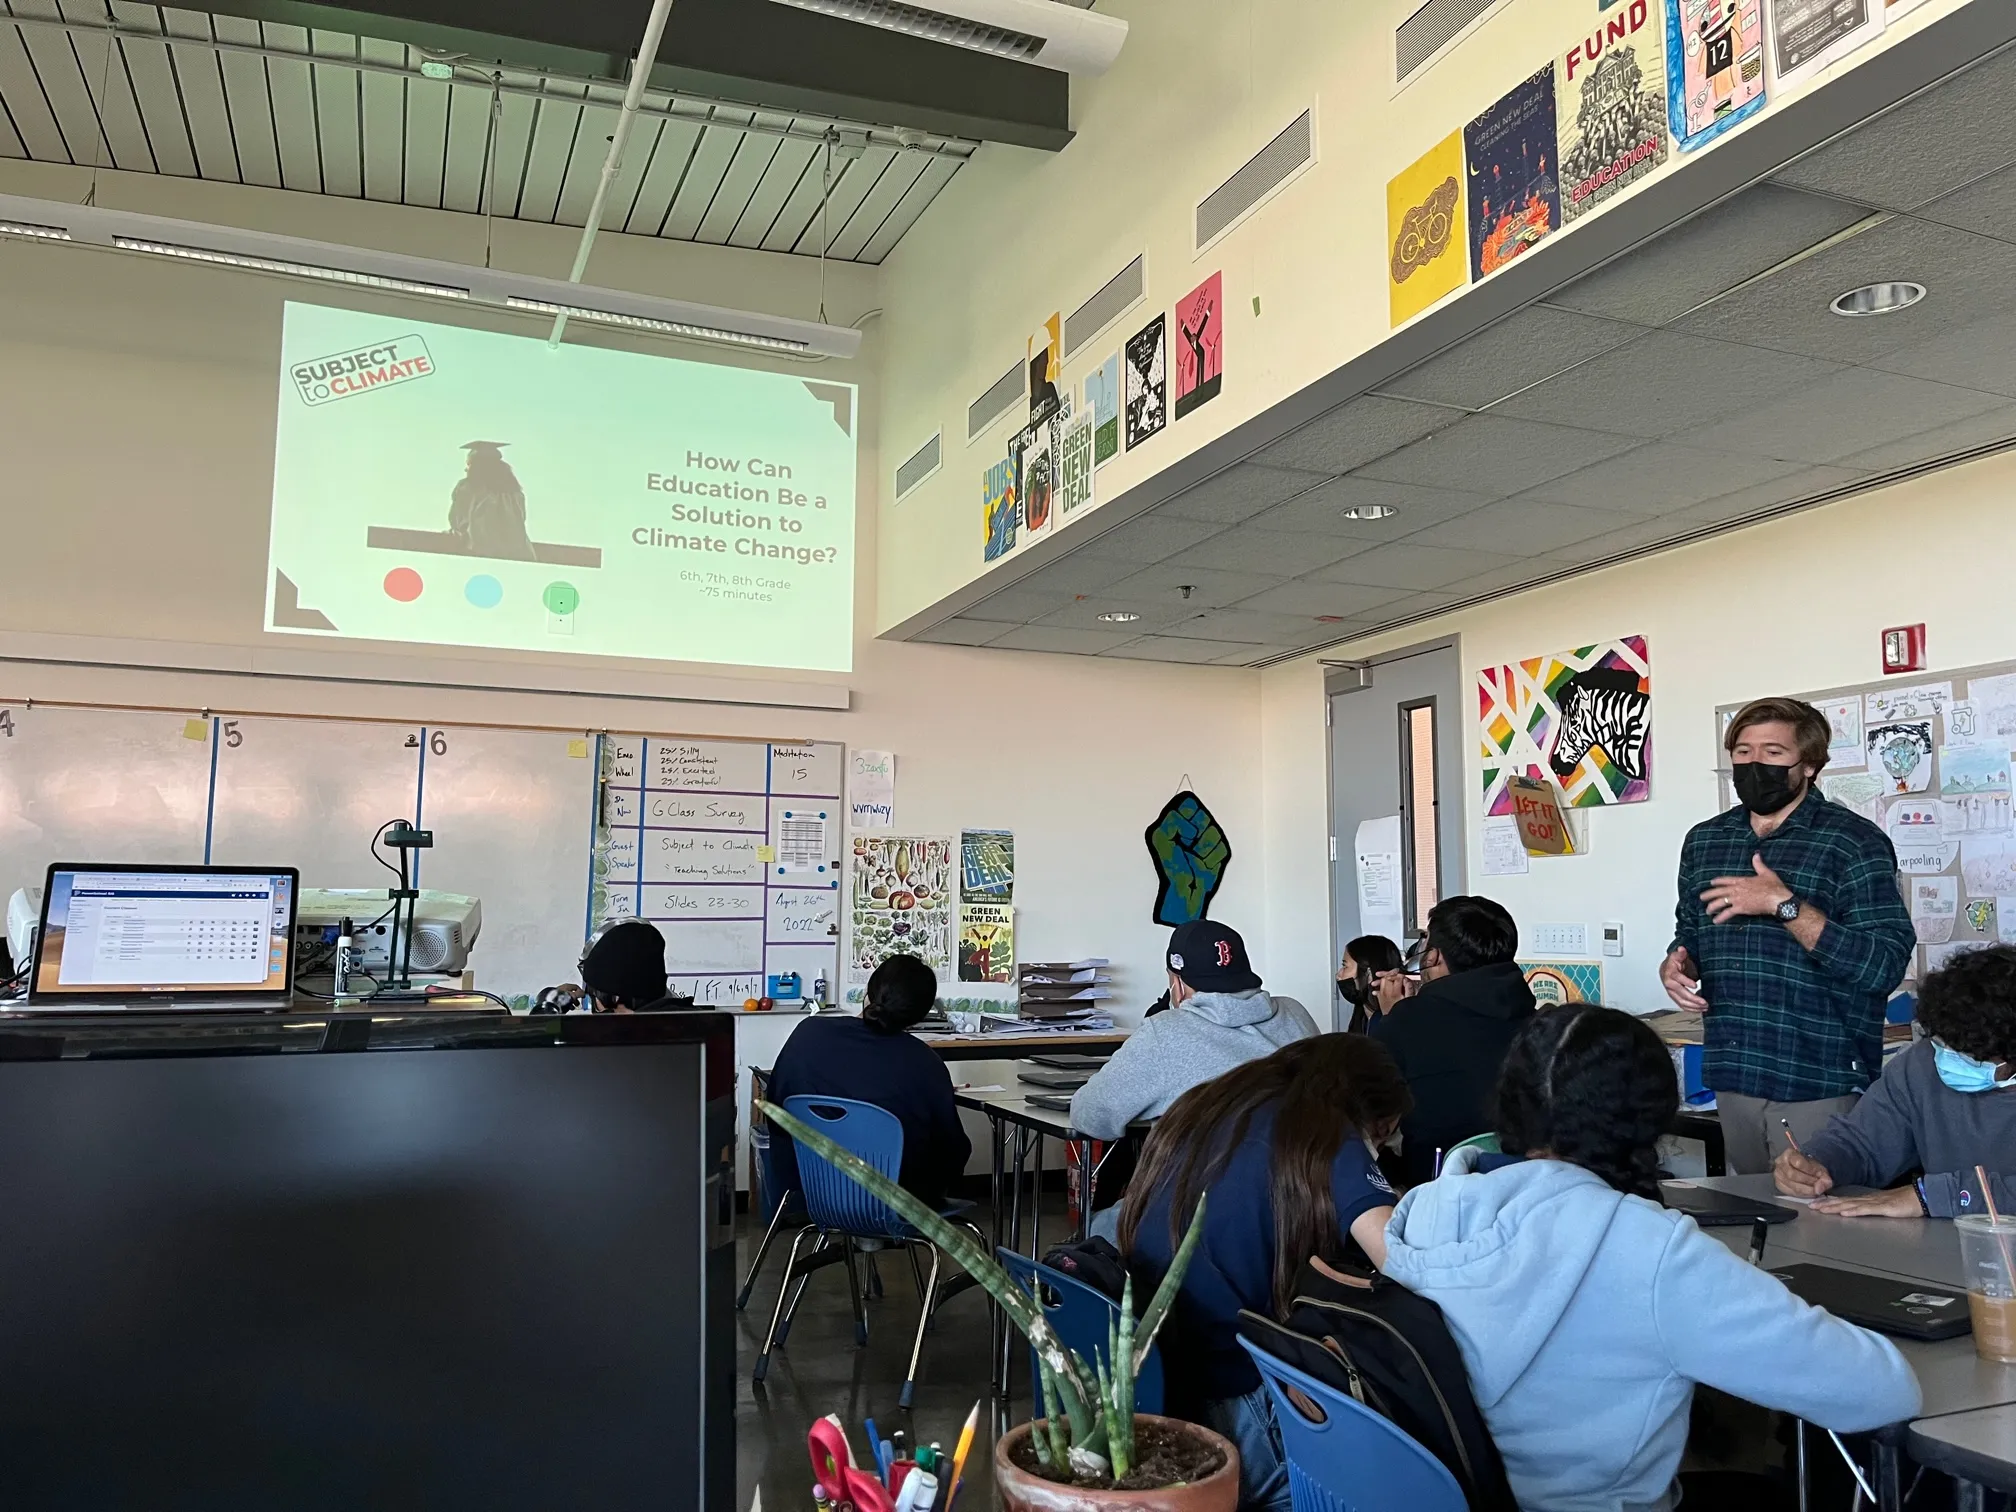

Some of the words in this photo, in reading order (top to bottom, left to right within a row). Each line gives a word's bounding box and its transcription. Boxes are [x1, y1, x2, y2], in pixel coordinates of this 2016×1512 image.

[1566, 0, 1647, 82] FUND
[1710, 39, 1728, 66] 12
[1474, 122, 1501, 146] GREEN
[1502, 106, 1521, 125] NEW
[1523, 84, 1544, 111] DEAL
[1480, 127, 1510, 152] CLEANING
[1510, 117, 1521, 130] THE
[1522, 104, 1539, 121] SEAS
[1572, 134, 1658, 204] EDUCATION
[295, 345, 398, 385] SUBJECT
[1063, 421, 1092, 458] GREEN
[686, 450, 740, 473] How
[747, 458, 792, 479] Can
[1063, 442, 1092, 488] NEW
[647, 473, 769, 503] Education
[777, 488, 808, 507] Be
[814, 495, 827, 509] a
[1063, 474, 1091, 514] DEAL
[671, 503, 771, 531] Solution
[779, 516, 802, 533] to
[631, 527, 727, 553] Climate
[734, 537, 838, 565] Change?
[679, 570, 704, 583] 6th,
[706, 572, 729, 586] 7th,
[732, 575, 753, 587] 8th
[756, 577, 791, 590] Grade
[699, 586, 720, 597] ~75
[723, 588, 773, 602] minutes
[0, 710, 15, 737] 4
[223, 720, 243, 748] 5
[430, 730, 448, 756] 6
[660, 747, 677, 755] 25%
[679, 747, 700, 756] Silly
[773, 748, 815, 760] Meditation
[615, 766, 634, 777] Wheel
[660, 757, 678, 765] 25%
[679, 756, 718, 765] Consistent
[791, 768, 807, 780] 15
[617, 806, 631, 817] Now
[667, 802, 696, 817] Class
[705, 802, 745, 825] Survey
[1515, 795, 1538, 818] LET
[1541, 803, 1555, 820] IT
[611, 840, 634, 851] Guest
[661, 837, 694, 853] Subject
[703, 840, 715, 850] to
[722, 839, 755, 850] Climate
[962, 844, 1000, 856] GREEN
[612, 857, 636, 869] Speaker
[963, 854, 999, 869] NEW
[1900, 853, 1942, 871] arpooling
[966, 865, 1013, 889] DEAL
[610, 894, 629, 906] Turn
[617, 905, 630, 913] In
[664, 895, 698, 909] Slides
[708, 897, 749, 909] 23-30
[971, 907, 1001, 915] GREEN
[783, 917, 814, 931] 2022
[962, 915, 983, 923] NEW
[985, 915, 1010, 923] DEAL
[341, 947, 352, 973] EXPO
[1214, 940, 1232, 966] B
